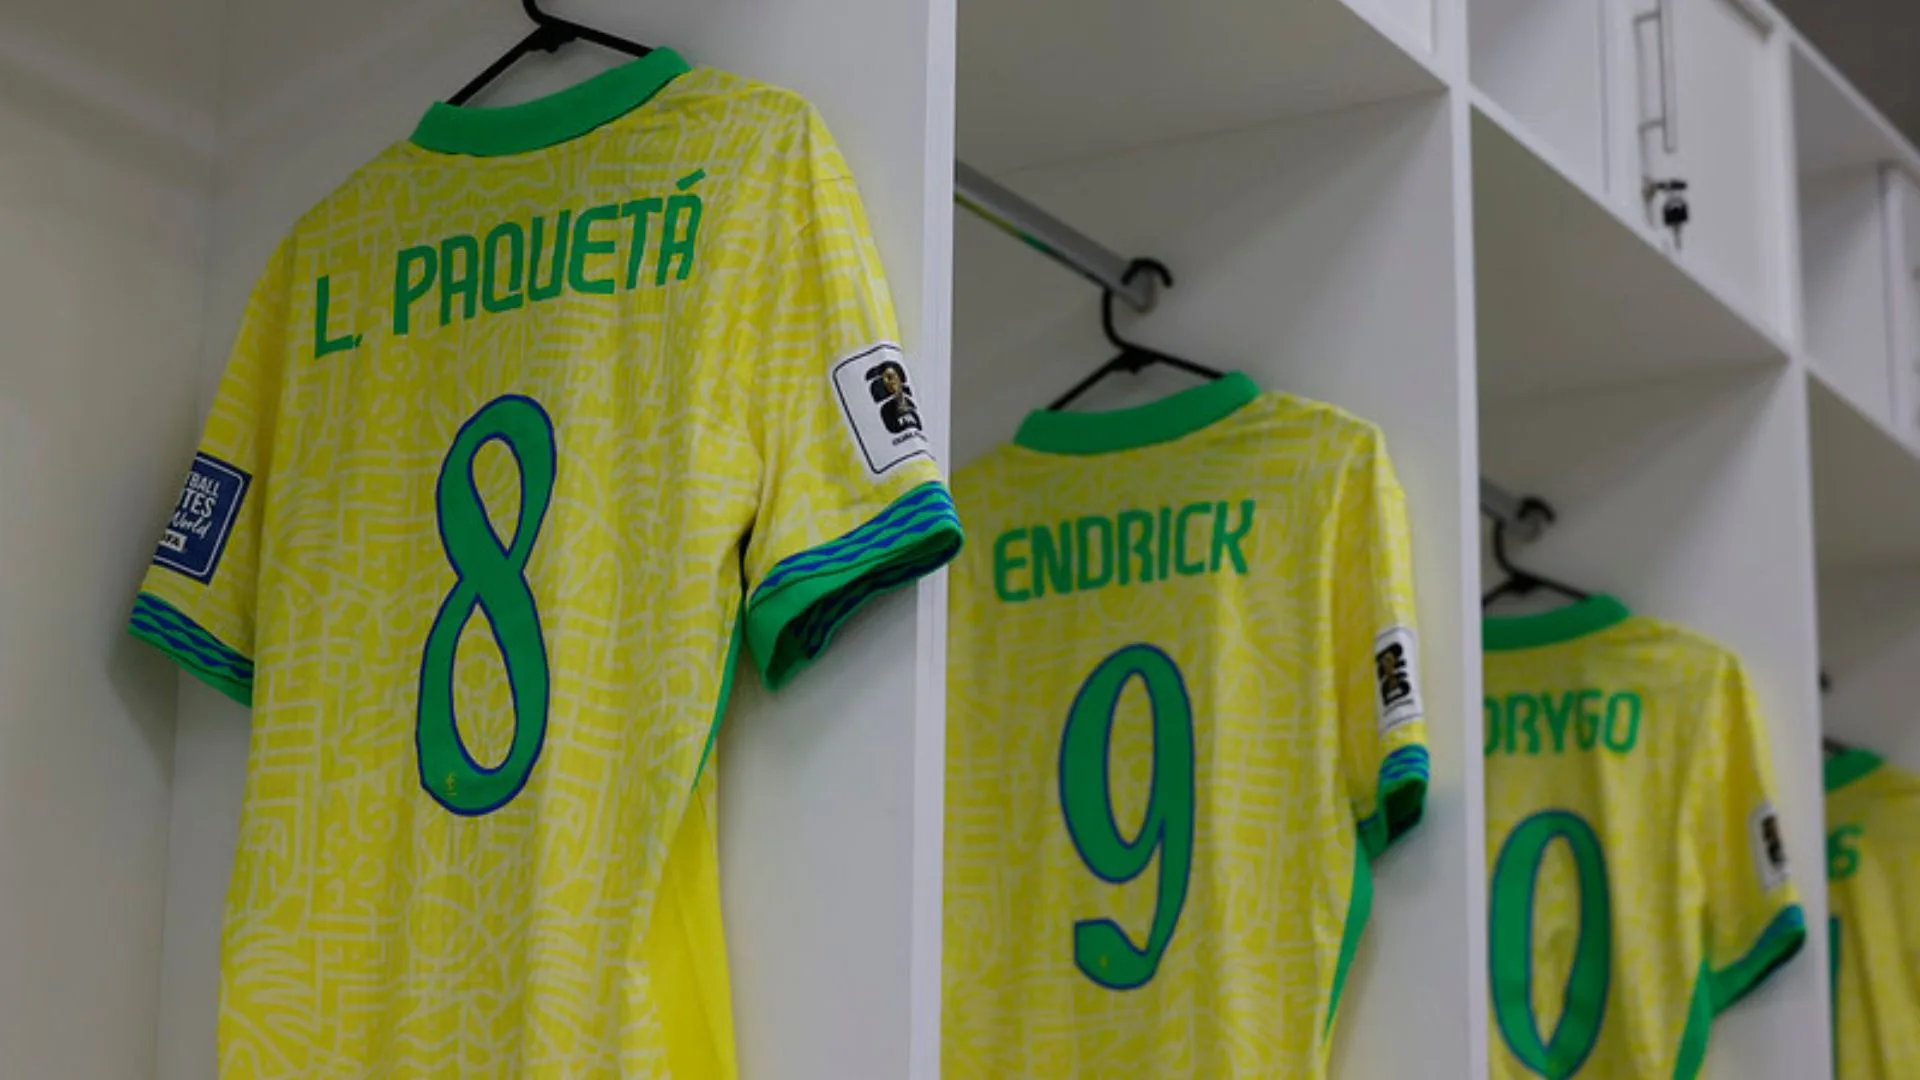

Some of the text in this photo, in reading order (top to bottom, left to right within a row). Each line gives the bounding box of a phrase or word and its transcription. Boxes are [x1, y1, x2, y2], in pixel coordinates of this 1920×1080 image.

[315, 169, 706, 359] L. PAQUETÁ
[415, 394, 557, 817] 8
[993, 498, 1255, 603] ENDRICK
[1058, 643, 1195, 991] 9
[1488, 809, 1611, 1080] 0
